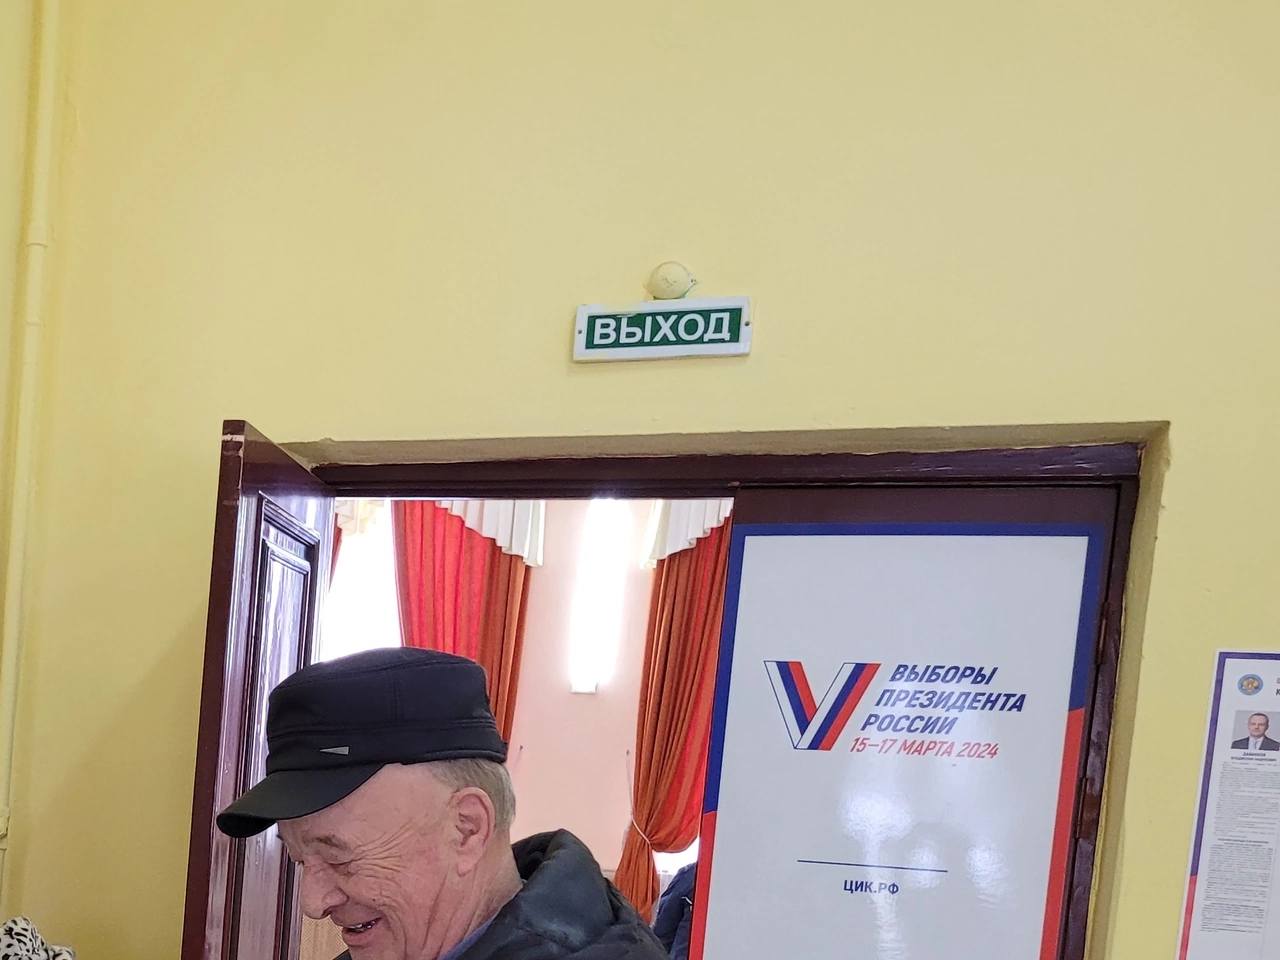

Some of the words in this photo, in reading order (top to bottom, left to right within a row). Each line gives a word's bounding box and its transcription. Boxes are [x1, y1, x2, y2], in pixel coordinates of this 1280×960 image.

[593, 312, 731, 345] ВЫХОД
[889, 664, 999, 686] ВЫБОРЫ
[874, 688, 1026, 713] ПРЕЗИДЕНТА
[860, 713, 959, 736] РОССИИ
[899, 739, 953, 758] МАРТА
[956, 742, 1000, 760] 2024
[843, 879, 899, 896] ЦИК.РФ
